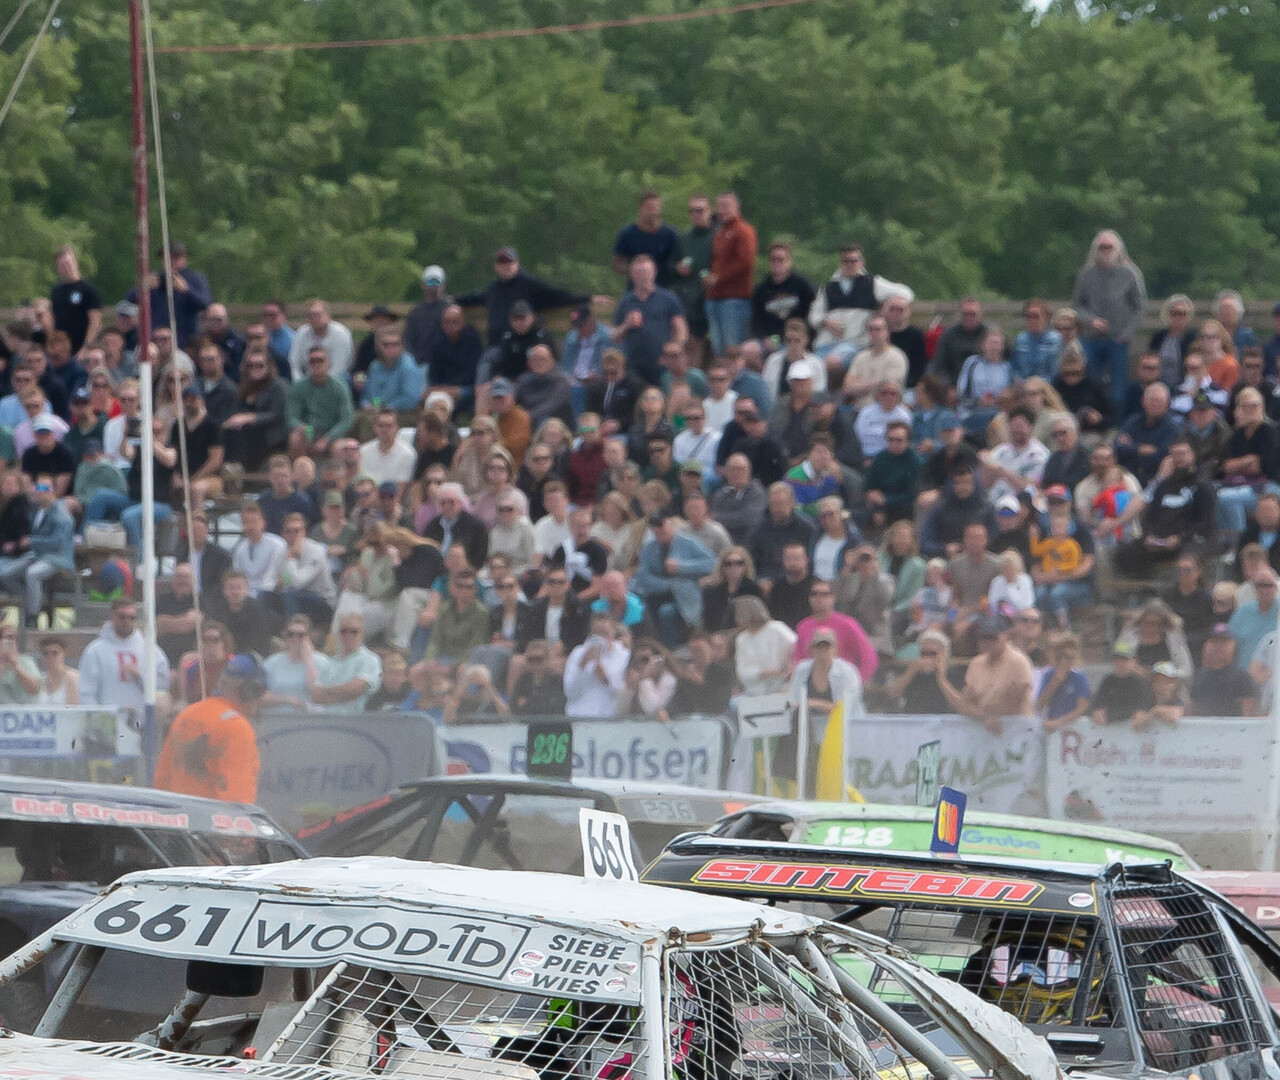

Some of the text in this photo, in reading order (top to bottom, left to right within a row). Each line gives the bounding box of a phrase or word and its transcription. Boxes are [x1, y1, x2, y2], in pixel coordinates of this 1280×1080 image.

[509, 737, 709, 781] Relofsen
[854, 742, 1029, 788] RAAKMAN
[587, 818, 635, 880] 661
[823, 826, 894, 847] 128
[696, 859, 1041, 902] SINTEBIN
[93, 900, 508, 969] 661 WOOD-ID
[548, 934, 626, 961] SIEBE
[531, 972, 600, 995] WIES
[541, 955, 610, 977] PIEN
